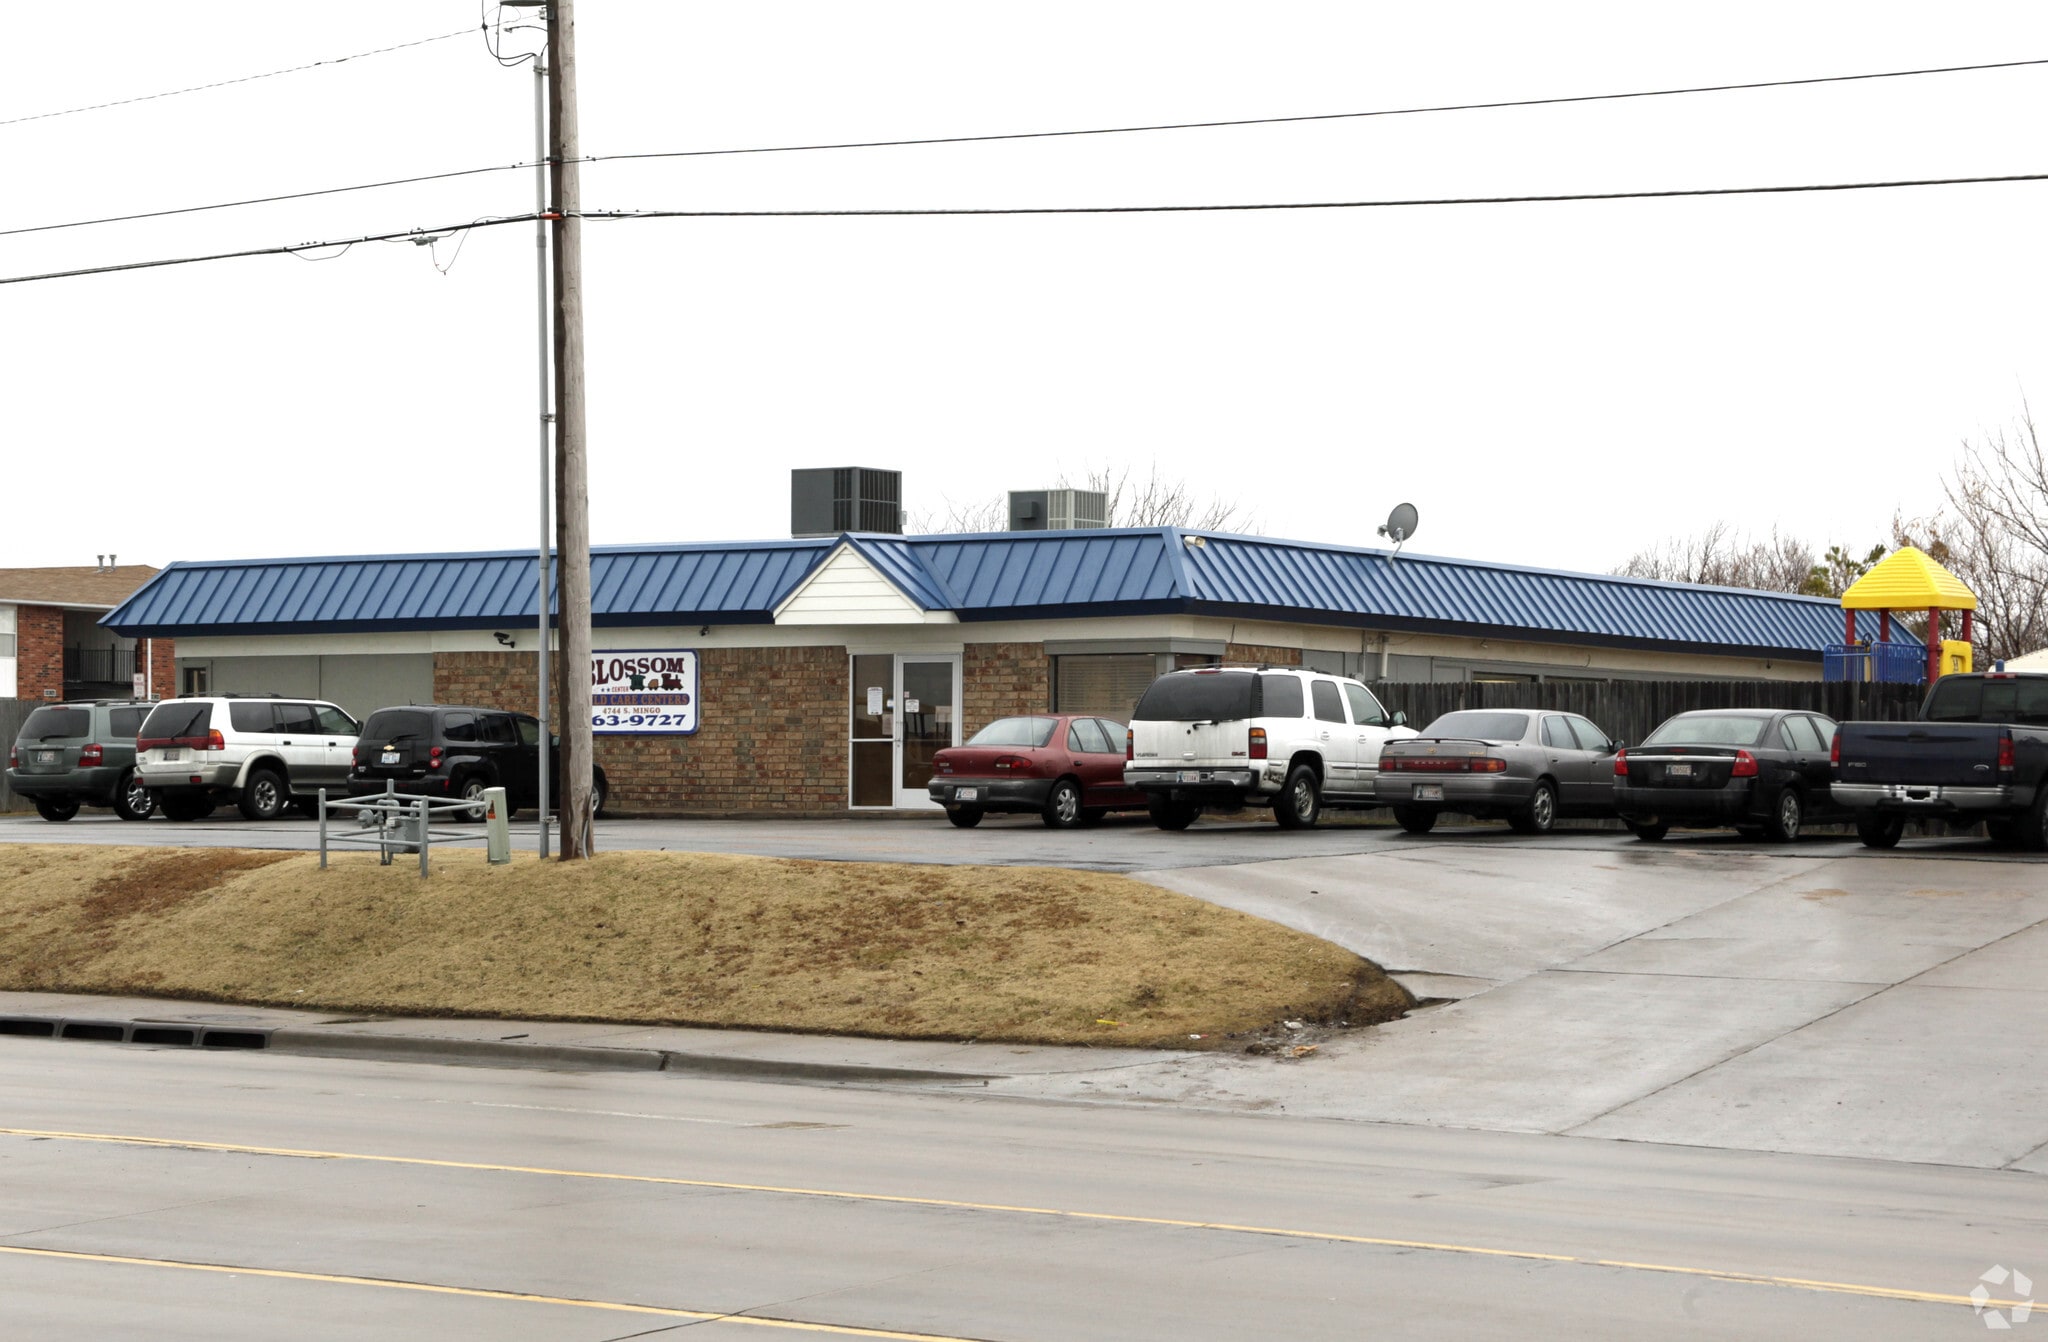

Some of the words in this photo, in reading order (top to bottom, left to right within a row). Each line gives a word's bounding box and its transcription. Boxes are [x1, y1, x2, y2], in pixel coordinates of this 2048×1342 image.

[592, 695, 607, 705] LD
[610, 694, 638, 705] CARE
[641, 694, 688, 705] CENTERS
